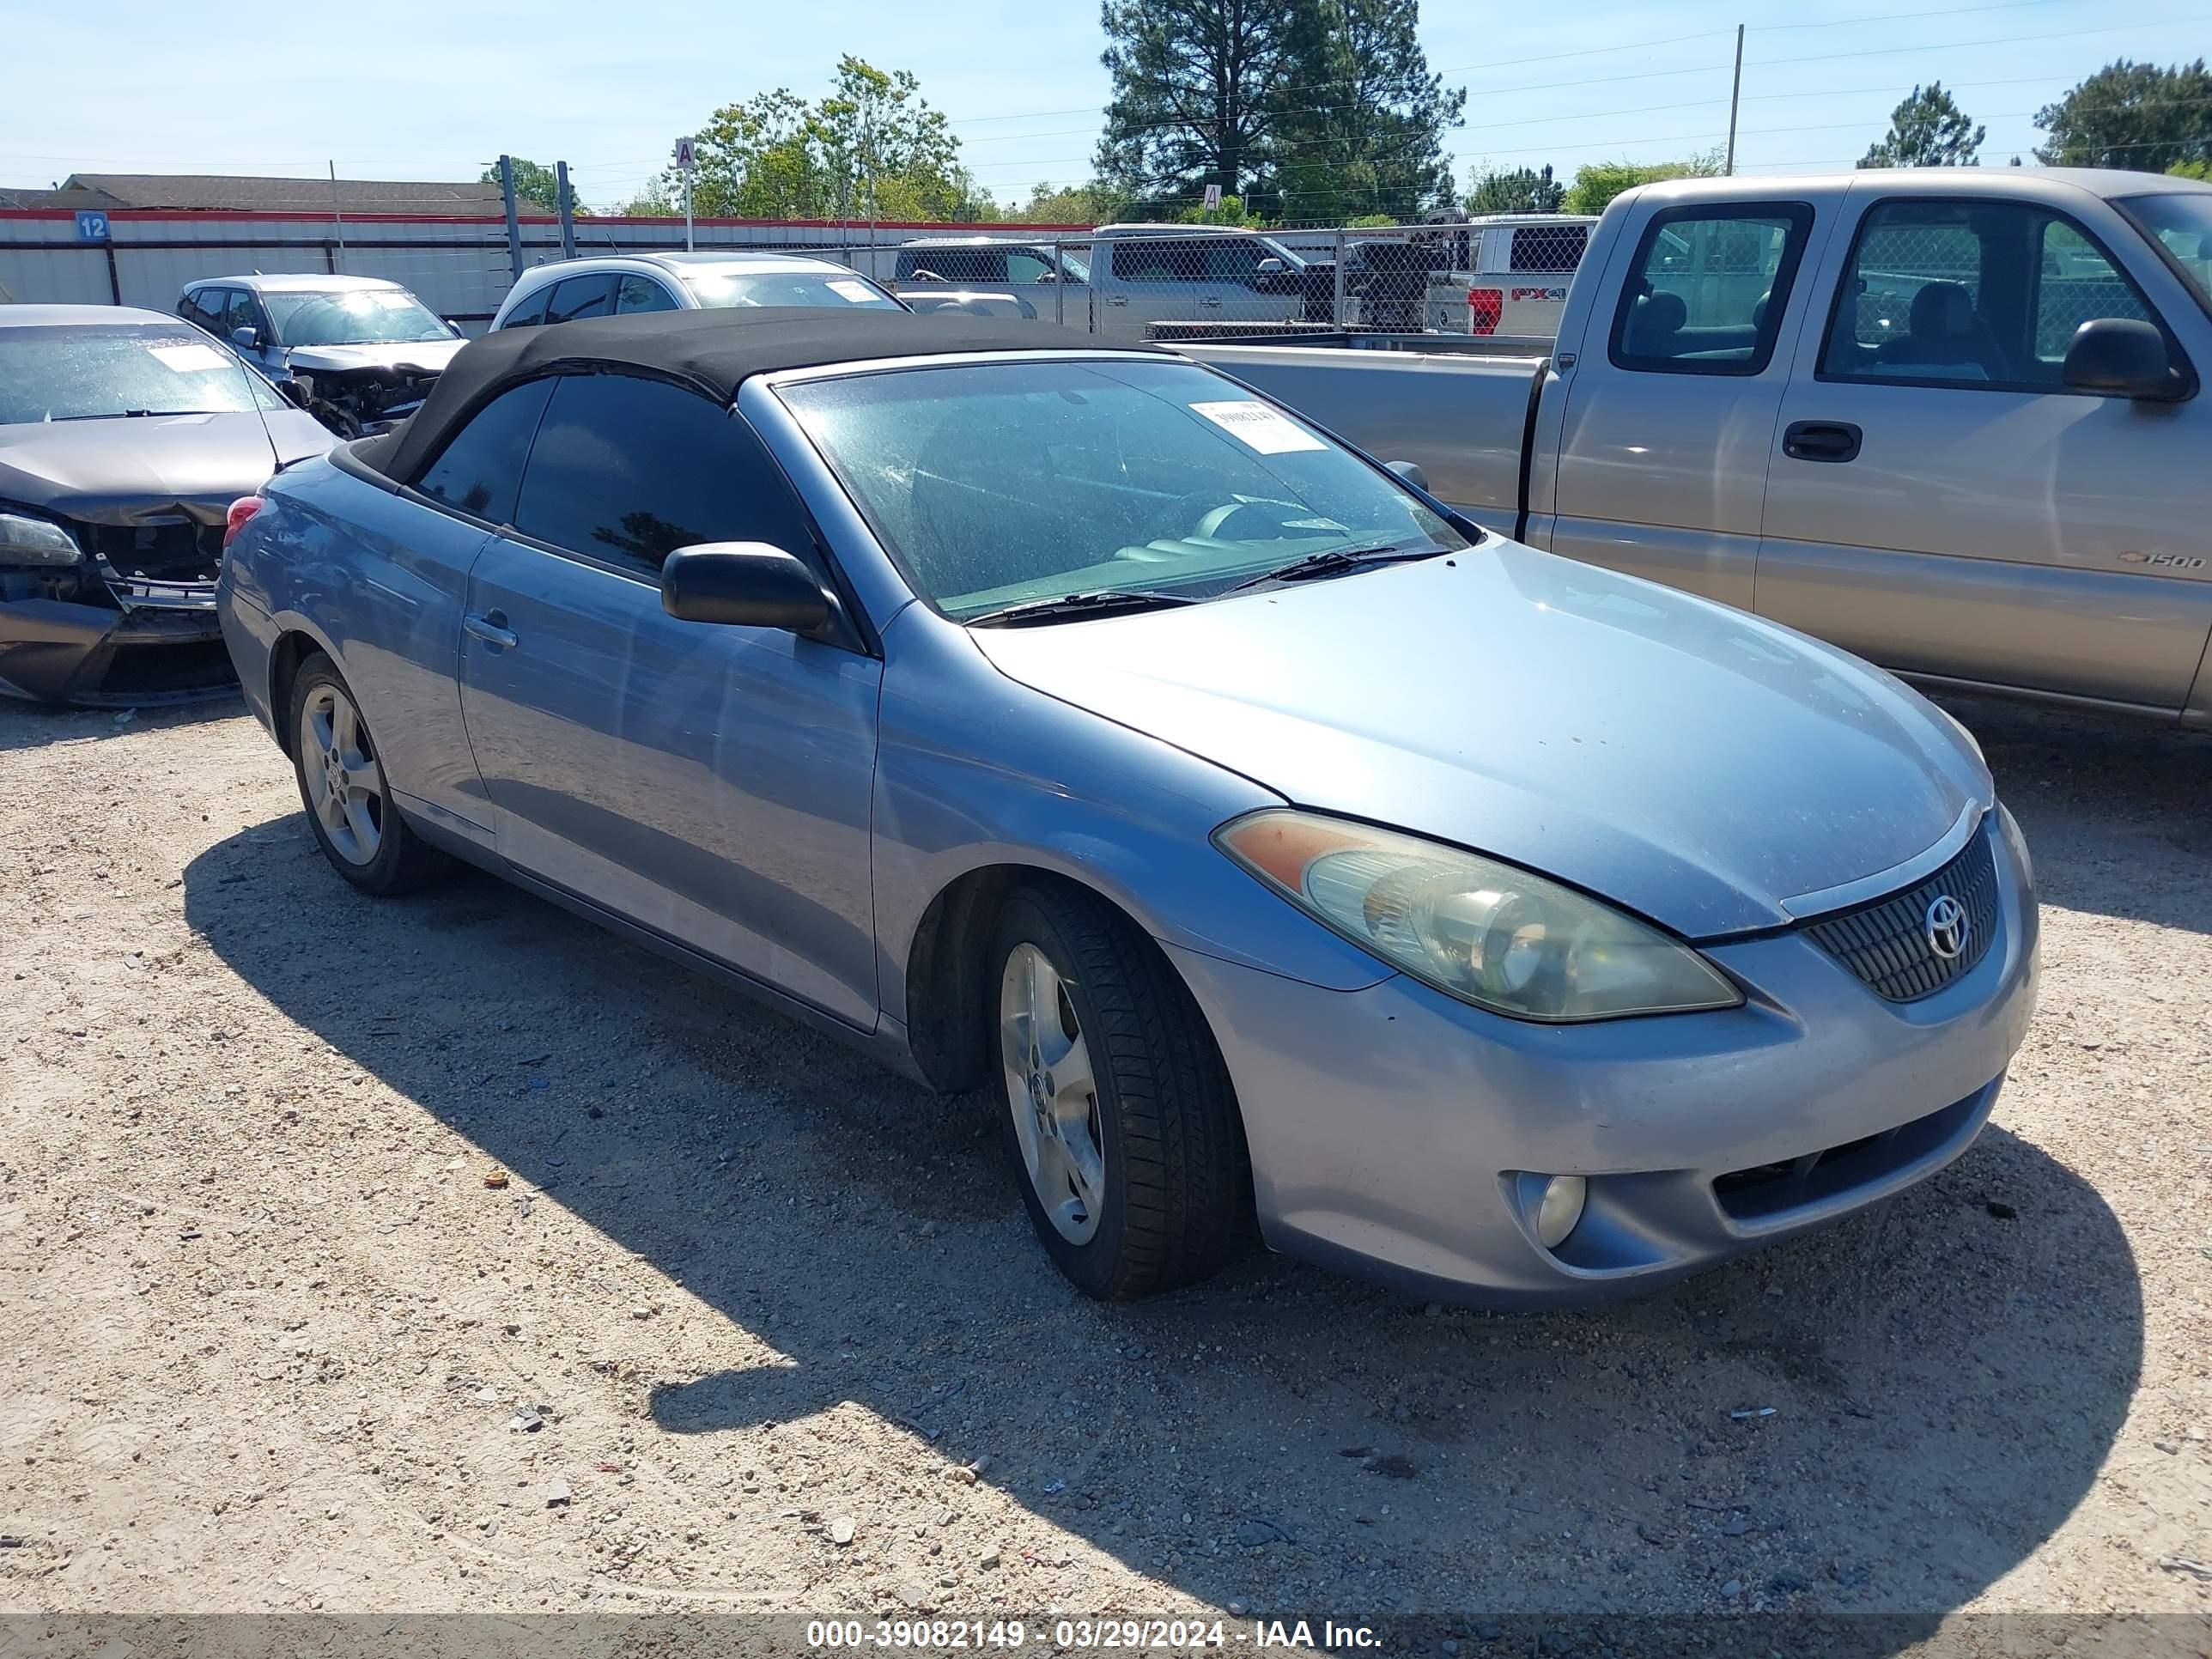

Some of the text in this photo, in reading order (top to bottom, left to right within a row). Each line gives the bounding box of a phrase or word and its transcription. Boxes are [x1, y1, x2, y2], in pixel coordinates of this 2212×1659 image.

[679, 143, 691, 162] A
[1206, 186, 1217, 209] A
[82, 217, 105, 237] 12
[2146, 554, 2207, 568] 1500
